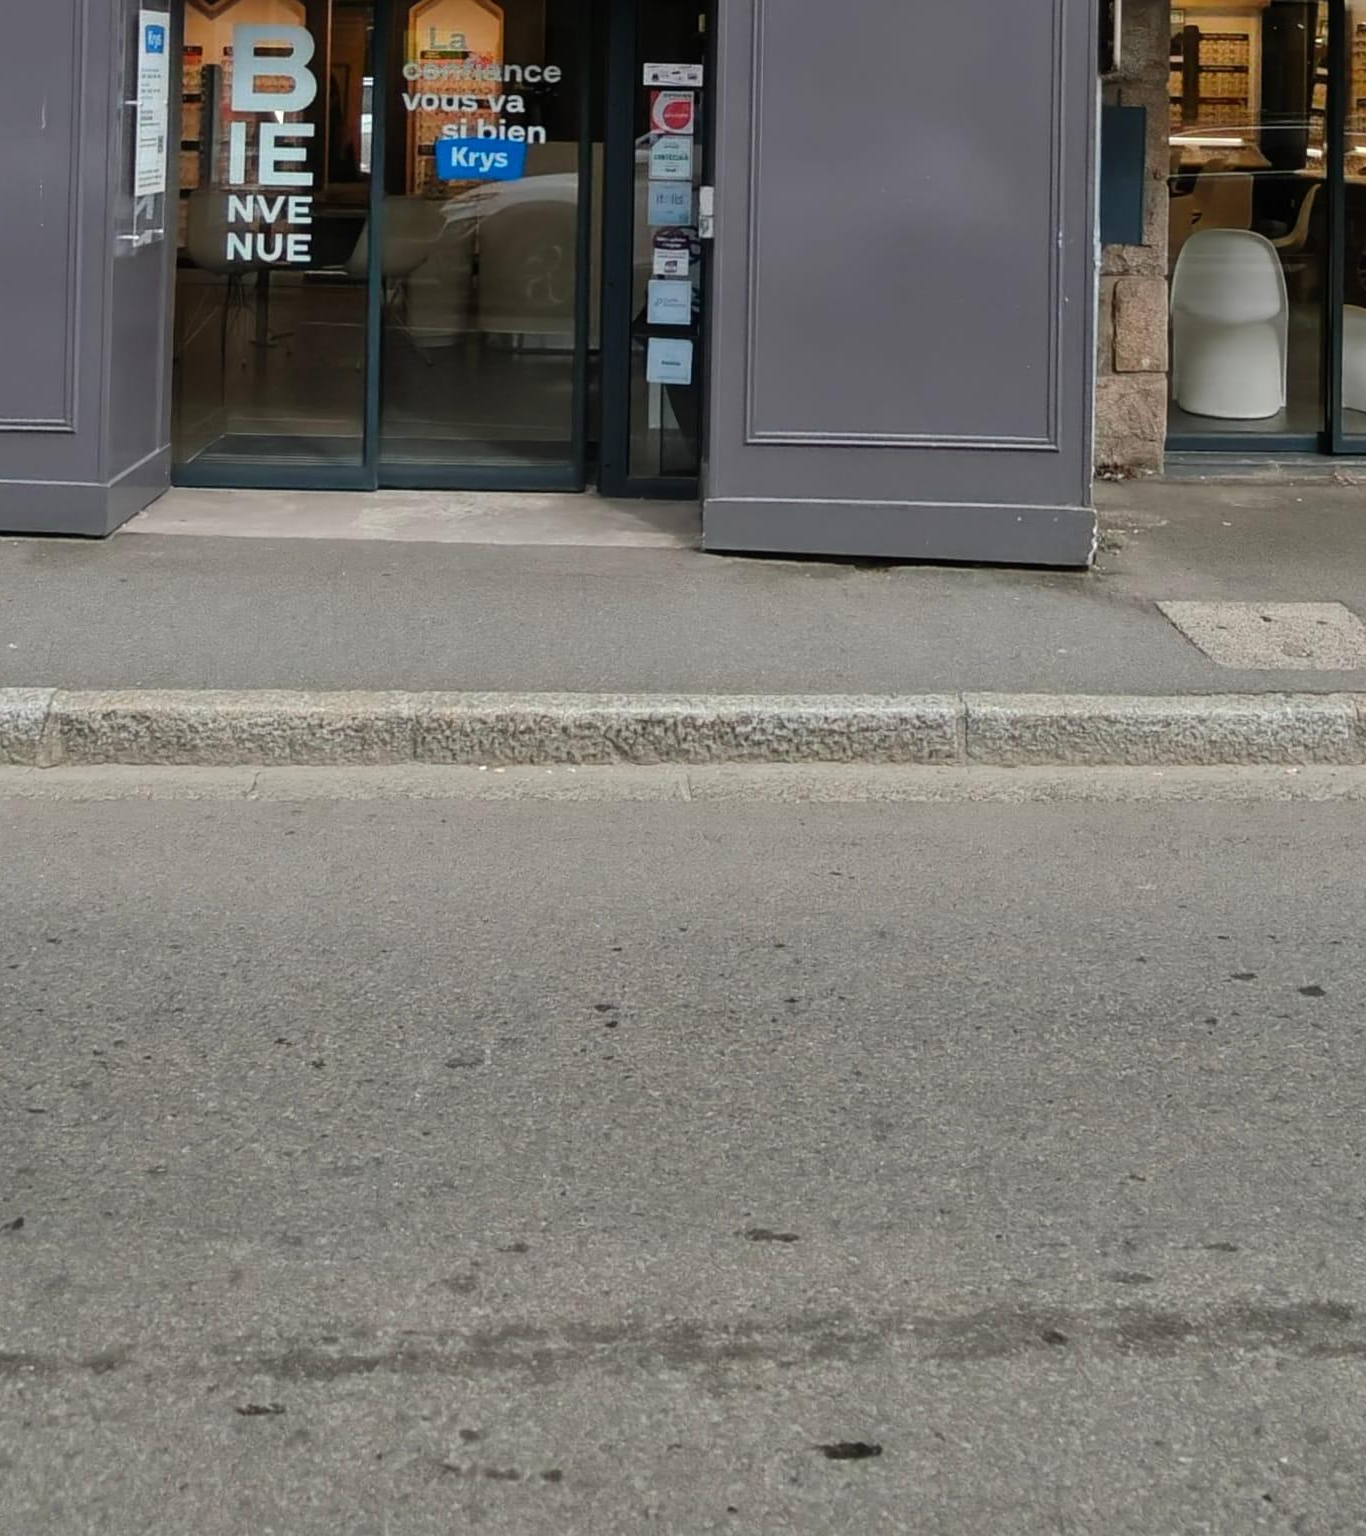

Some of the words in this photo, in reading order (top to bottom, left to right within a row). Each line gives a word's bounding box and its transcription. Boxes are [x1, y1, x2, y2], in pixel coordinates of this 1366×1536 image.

[430, 27, 467, 50] La
[402, 61, 562, 84] confiance
[402, 92, 478, 112] vous
[485, 93, 525, 113] va
[441, 119, 467, 141] si
[477, 119, 546, 144] bien
[451, 146, 508, 173] Krys
[227, 194, 313, 224] NVE
[226, 232, 312, 262] NUE
